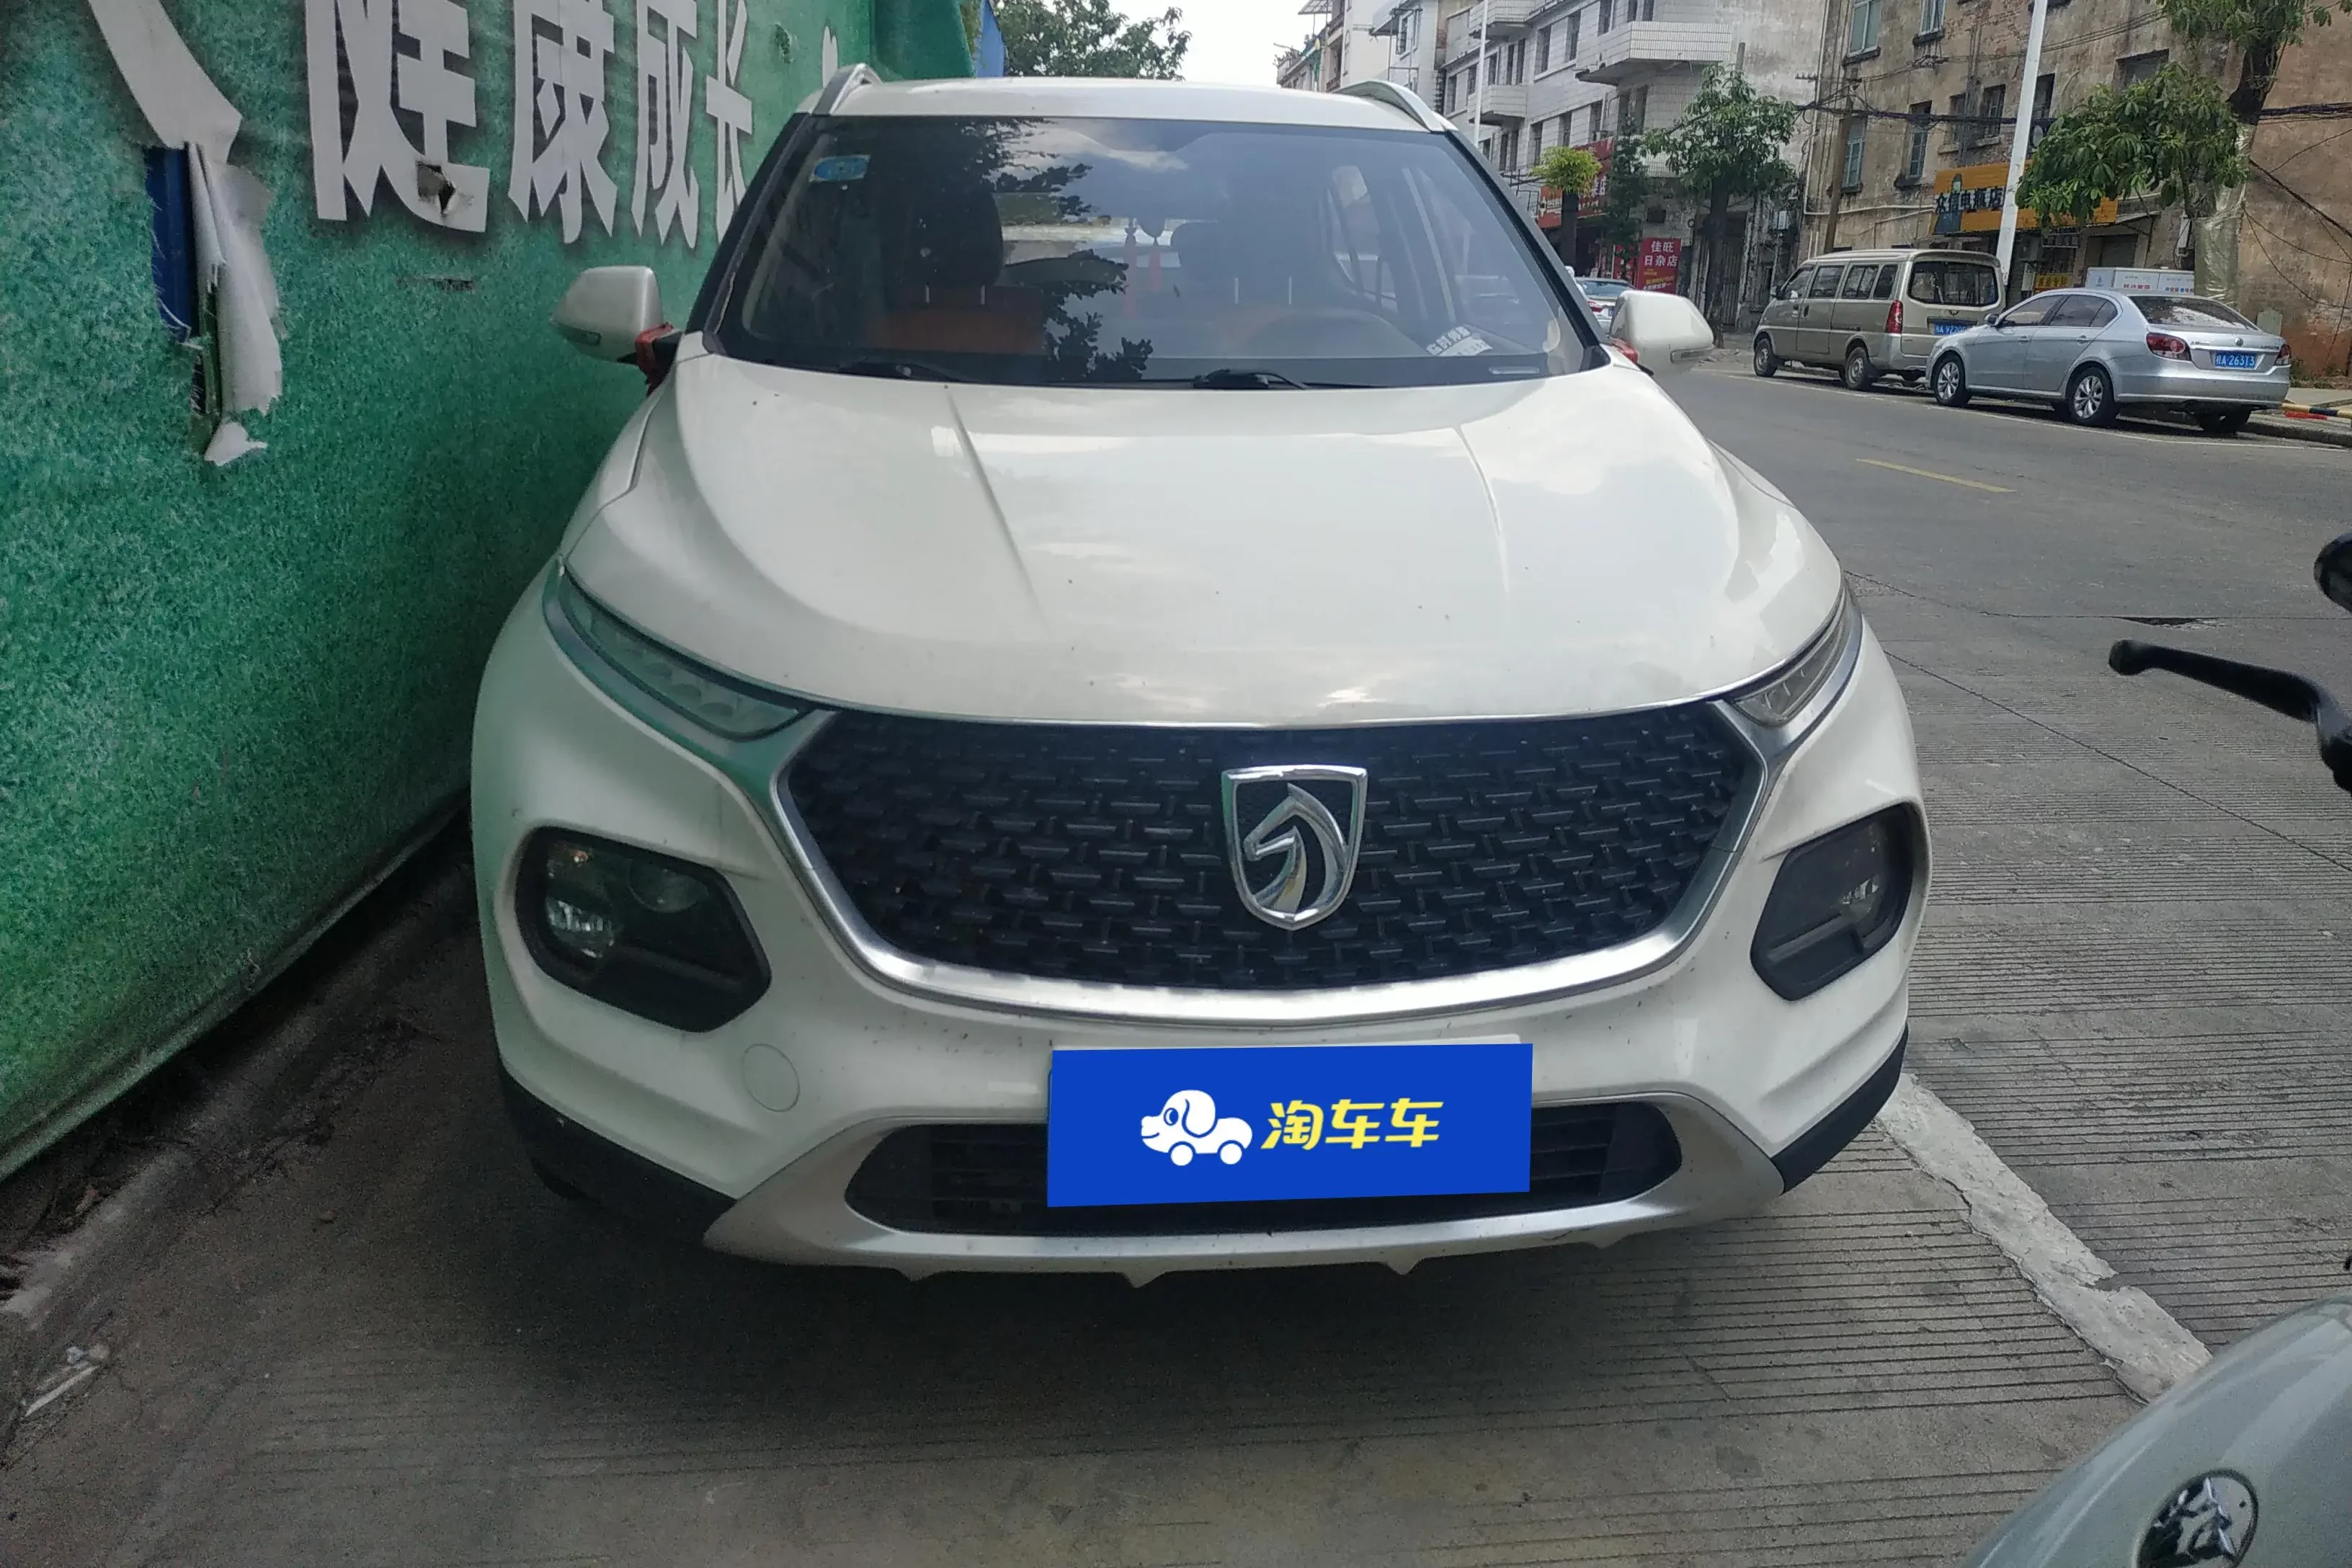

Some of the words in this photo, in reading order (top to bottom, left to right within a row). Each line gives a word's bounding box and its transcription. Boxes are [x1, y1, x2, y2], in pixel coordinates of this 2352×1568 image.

[1651, 241, 1675, 253] 佳旺
[1644, 254, 1678, 267] 日杂店
